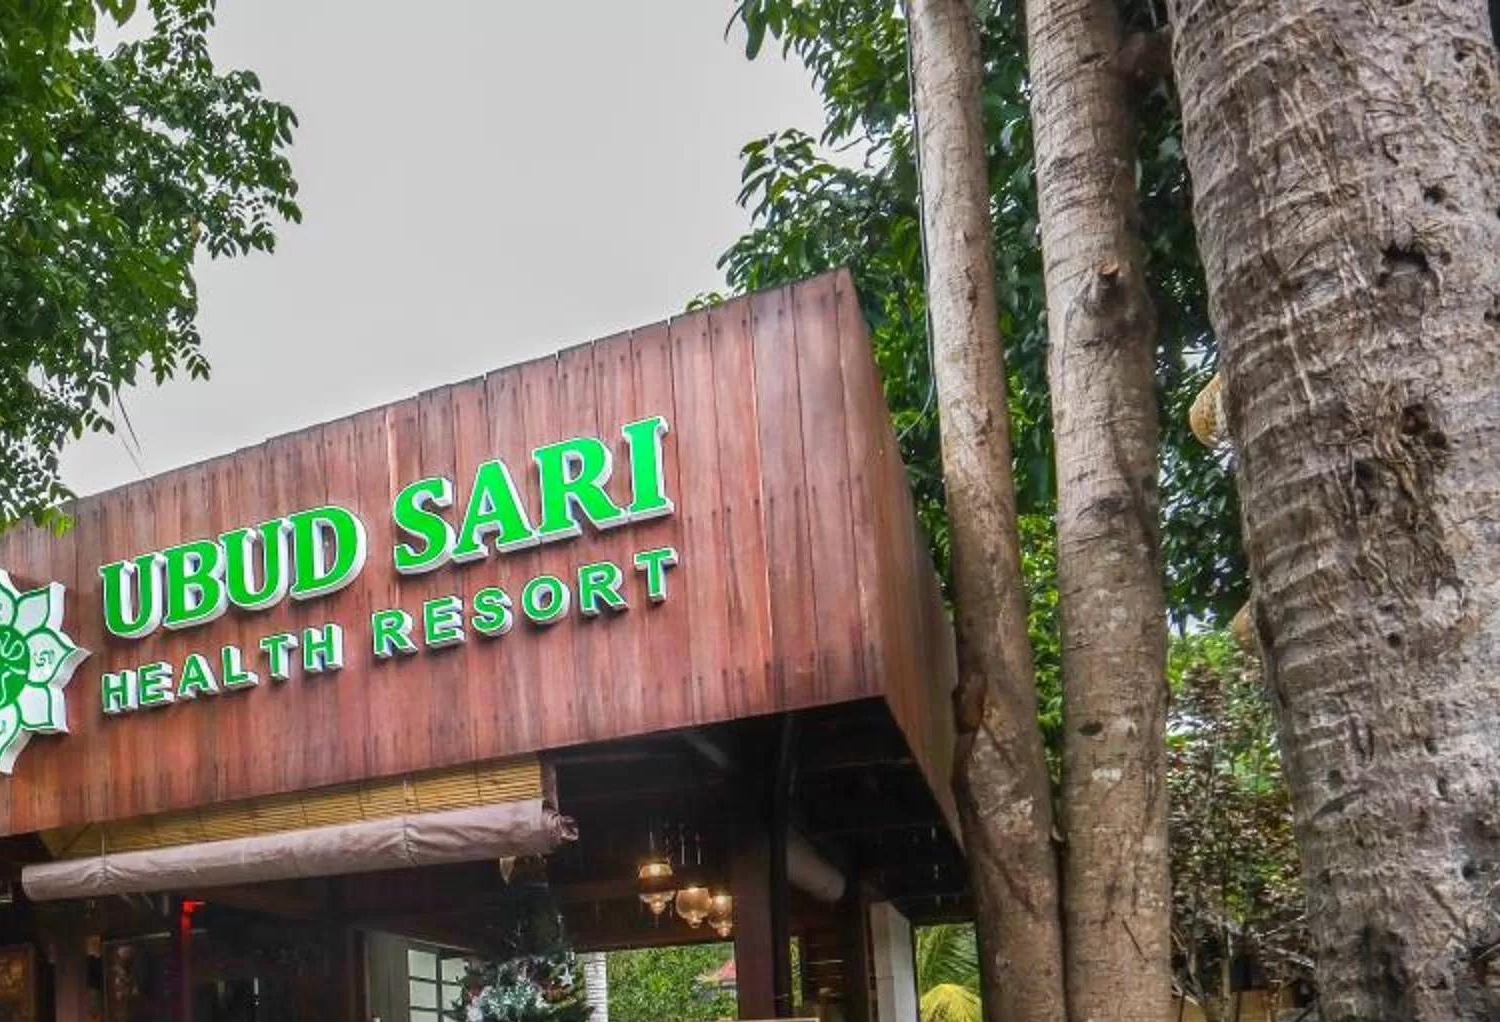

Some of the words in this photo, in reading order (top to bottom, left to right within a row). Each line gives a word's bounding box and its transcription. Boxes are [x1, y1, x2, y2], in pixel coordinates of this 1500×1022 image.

[99, 505, 367, 639] UBUD
[394, 416, 674, 574] SARI
[101, 623, 344, 714] HEALTH
[372, 547, 679, 657] RESORT
